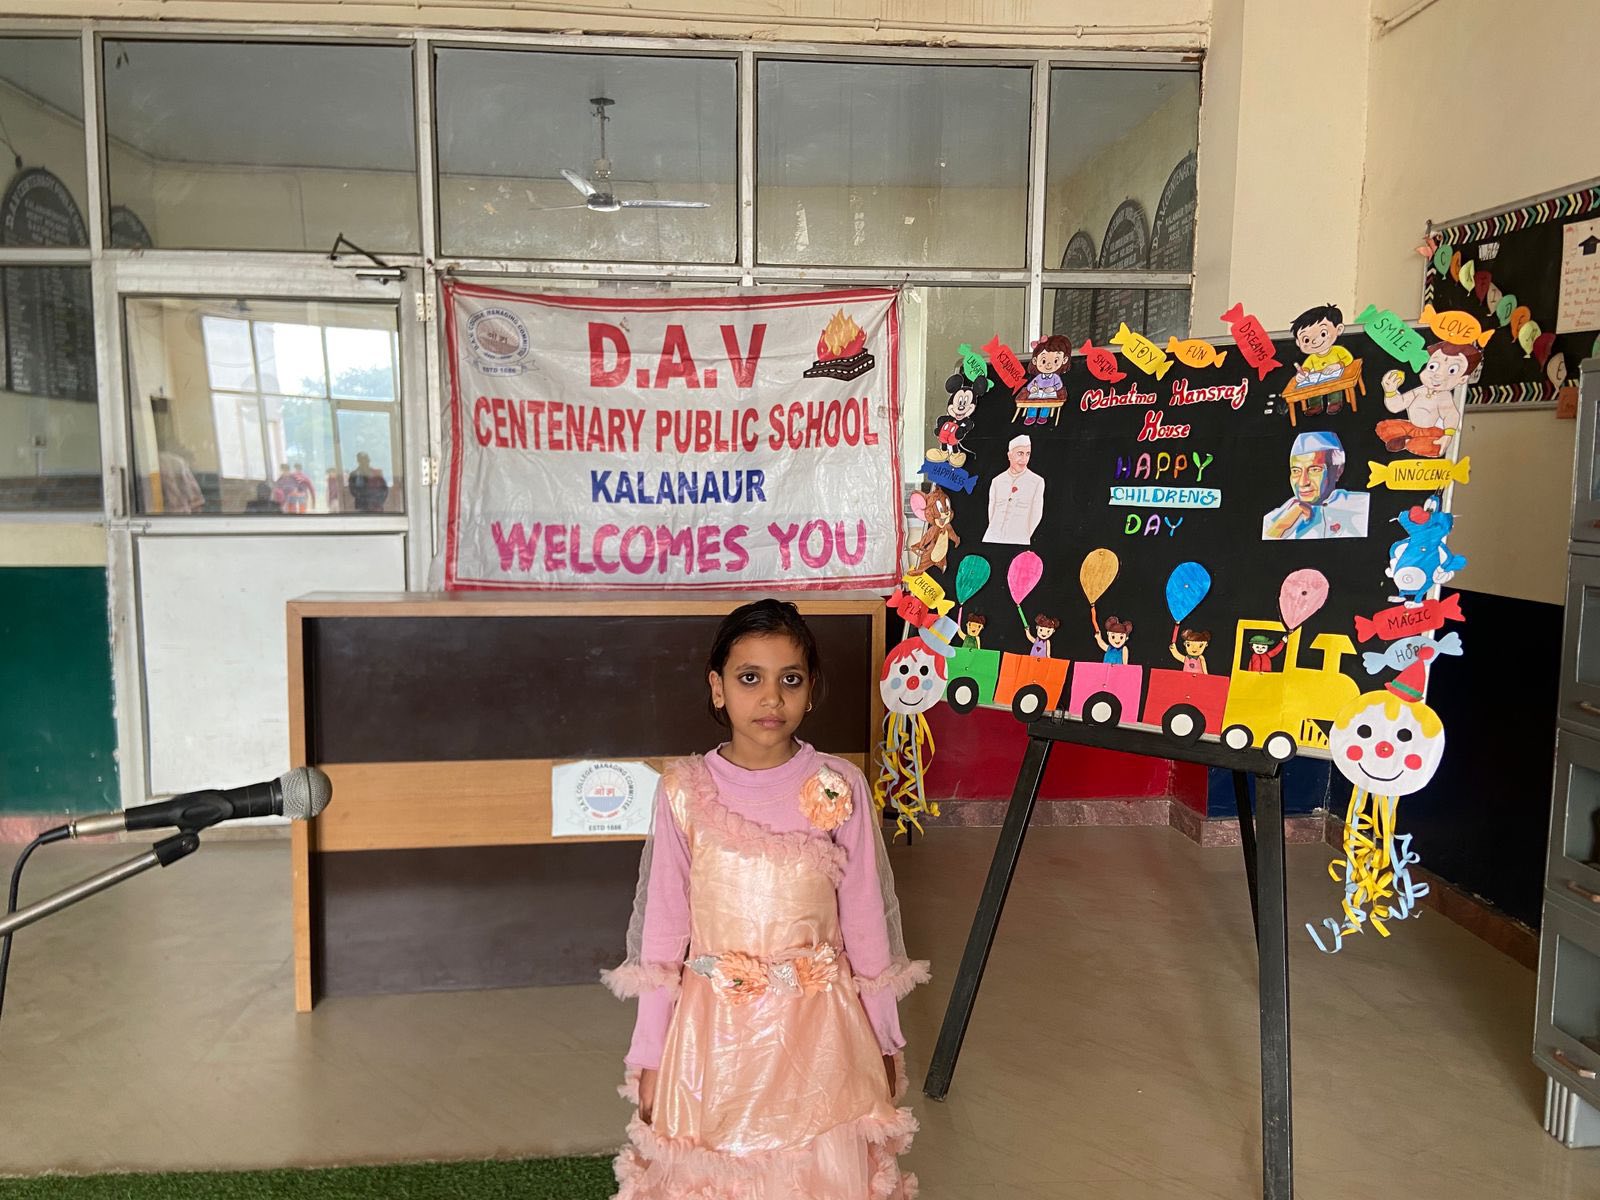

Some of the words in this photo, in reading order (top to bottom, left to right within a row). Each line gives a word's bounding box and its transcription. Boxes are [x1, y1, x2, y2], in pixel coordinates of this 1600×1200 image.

[1239, 321, 1268, 361] DREAMS
[1374, 318, 1412, 352] SMILE
[1439, 315, 1474, 338] LOVE
[588, 322, 768, 389] D.A.V
[1093, 354, 1116, 376] SHINE
[1129, 338, 1157, 365] JOY
[1186, 345, 1207, 360] FUN
[1080, 382, 1157, 411] Mahatma
[1169, 378, 1249, 410] Hansraj
[473, 397, 646, 453] CENTENARY
[656, 408, 760, 453] PUBLIC
[768, 397, 880, 452] SCHOOL
[1136, 410, 1191, 442] House
[933, 465, 965, 486] HAPPINESS
[1114, 452, 1214, 482] HAPPY
[1394, 467, 1451, 482] INNOCENCE
[590, 468, 767, 505] KALANAUR
[1124, 513, 1184, 537] DAY
[491, 521, 750, 574] WELCOMES
[767, 518, 867, 571] YOU
[1387, 608, 1431, 630] MAGIC
[1395, 643, 1427, 663] HOP
[594, 763, 628, 777] MANAGING
[625, 775, 634, 811] COMMITTEE
